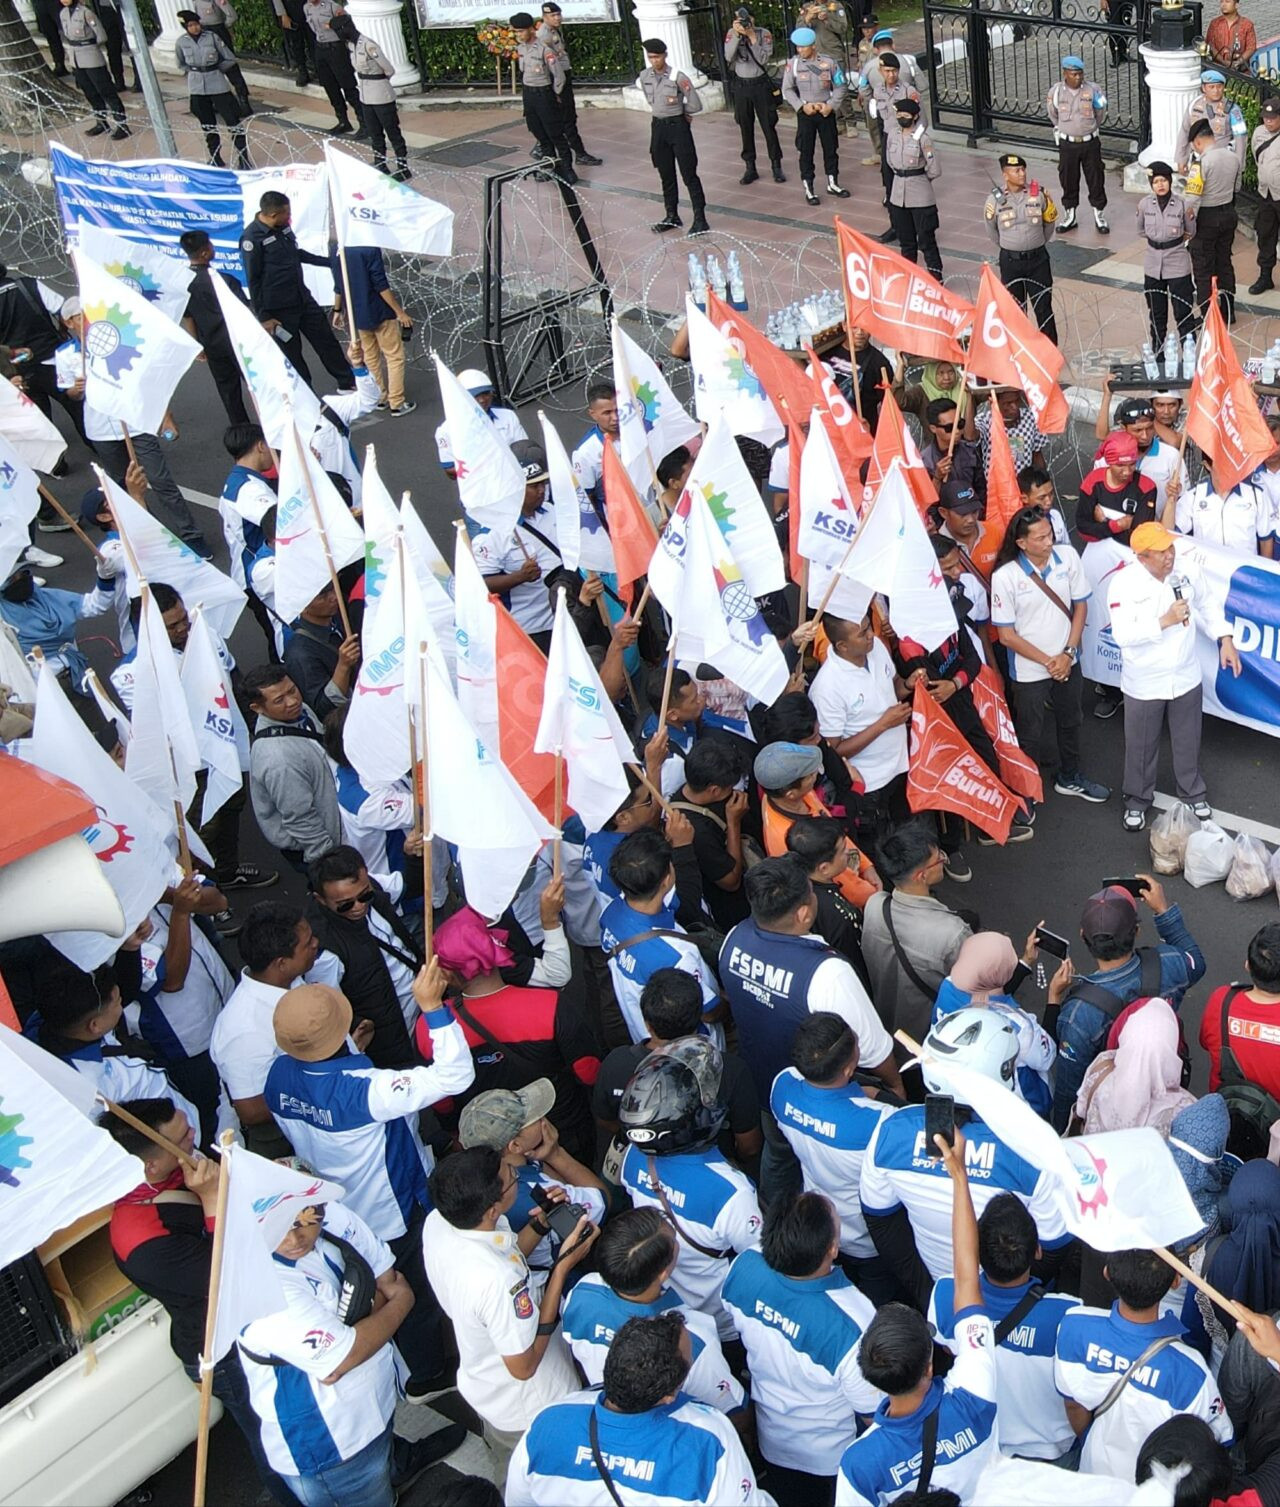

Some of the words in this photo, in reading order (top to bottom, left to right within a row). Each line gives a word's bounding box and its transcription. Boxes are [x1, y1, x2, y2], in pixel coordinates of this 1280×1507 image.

[846, 252, 871, 300] 6
[909, 297, 962, 326] Buruh
[982, 301, 1009, 348] 6
[944, 766, 1004, 809] Buruh
[728, 946, 794, 994] FSPMI
[1230, 1019, 1241, 1034] 6
[279, 1092, 334, 1128] FSPMI
[784, 1101, 836, 1139] FSPMI
[754, 1299, 801, 1340] FSPMI
[1086, 1342, 1161, 1389] FSPMI
